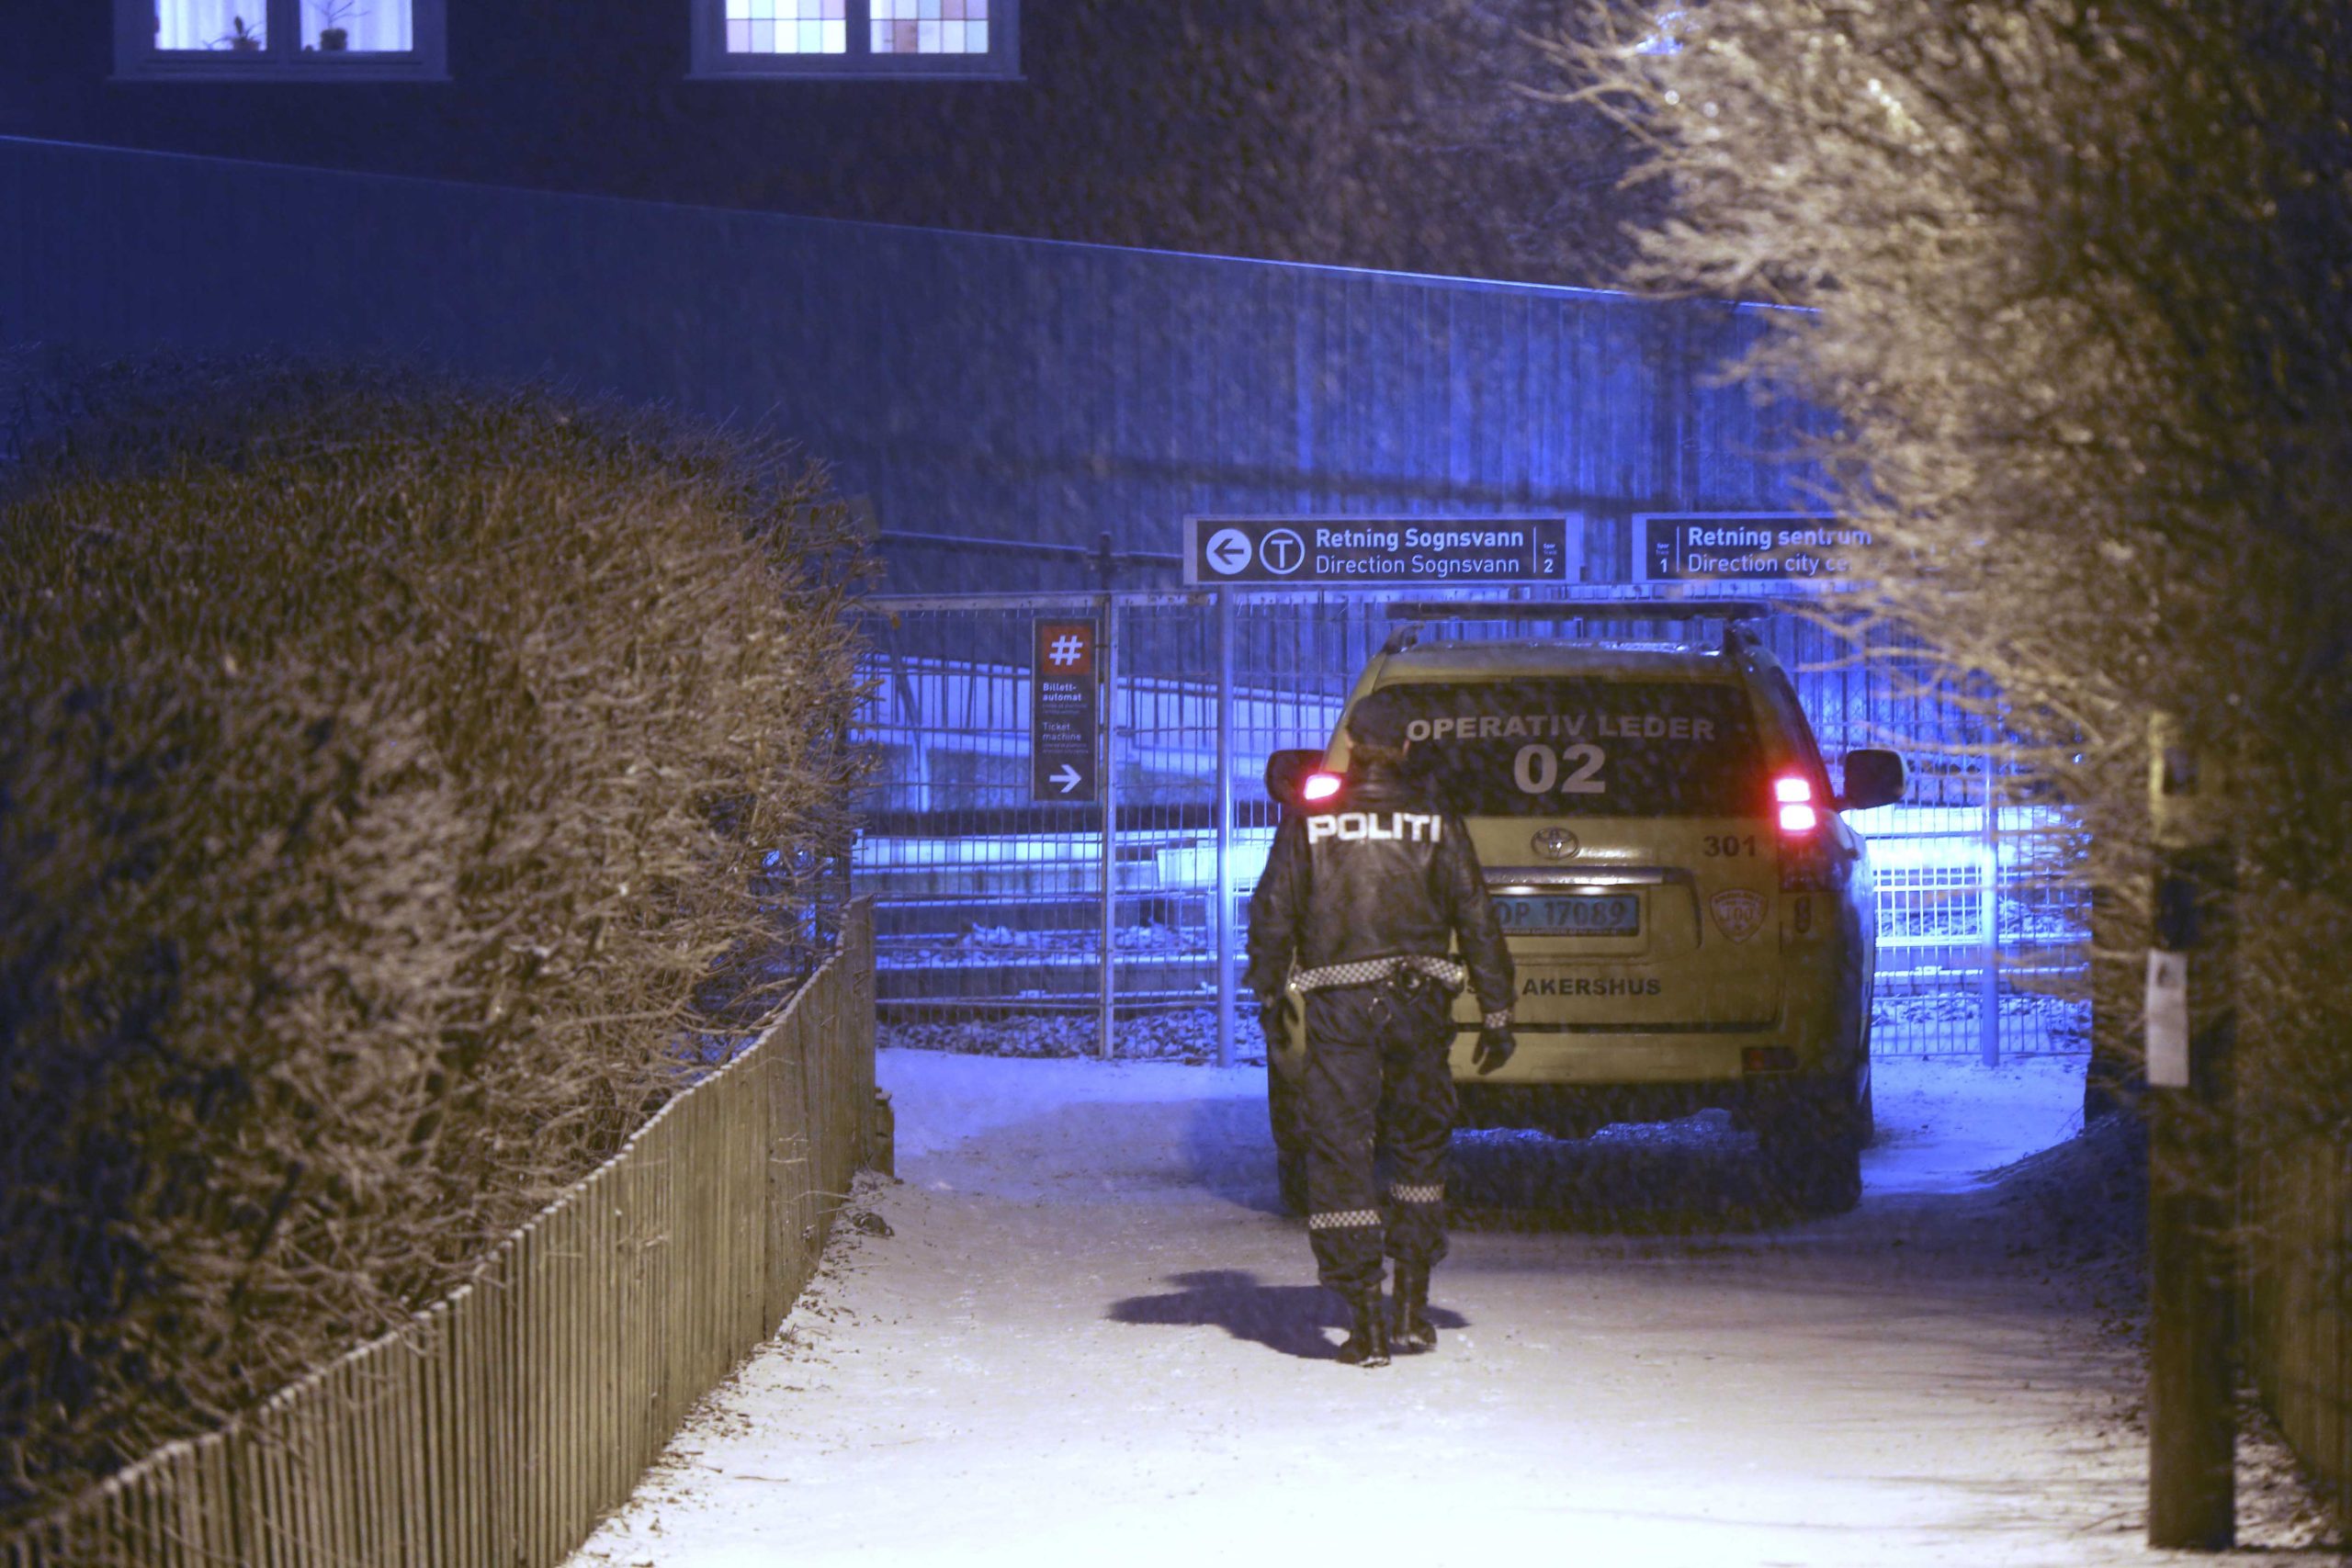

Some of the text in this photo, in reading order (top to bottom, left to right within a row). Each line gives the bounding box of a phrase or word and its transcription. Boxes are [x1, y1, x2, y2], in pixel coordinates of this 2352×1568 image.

[1316, 527, 1524, 551] Retning Sognsvann
[1688, 526, 1872, 550] Retning sentrum
[1316, 554, 1520, 578] Direction Sognsvann
[1544, 558, 1554, 573] 2
[1660, 558, 1668, 573] 1
[1688, 554, 1778, 573] Direction
[1784, 553, 1820, 576] city
[1043, 694, 1082, 702] automat
[1043, 722, 1070, 731] Ticket
[1407, 715, 1716, 741] OPERATIV LEDER
[1513, 744, 1606, 795] 02
[1306, 812, 1442, 844] POLITI
[1703, 835, 1756, 857] 301
[1521, 978, 1661, 996] AKERSHUS
